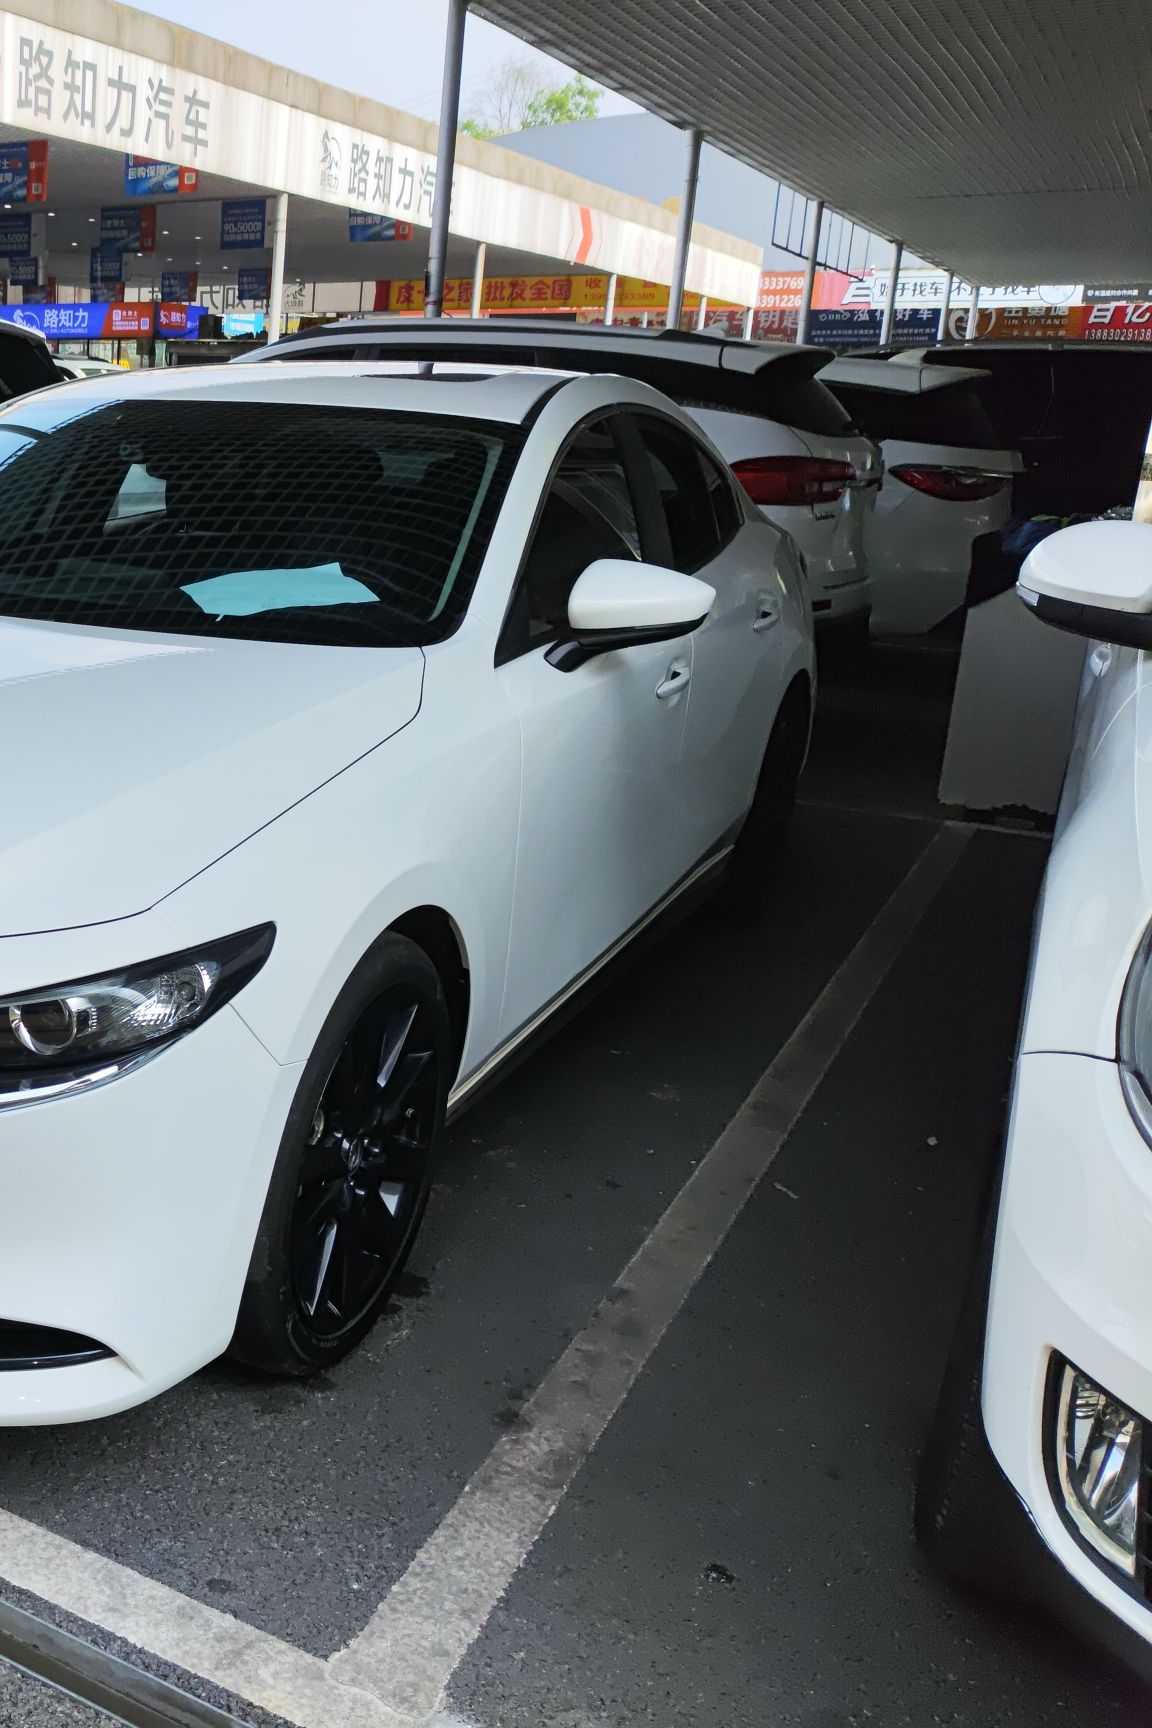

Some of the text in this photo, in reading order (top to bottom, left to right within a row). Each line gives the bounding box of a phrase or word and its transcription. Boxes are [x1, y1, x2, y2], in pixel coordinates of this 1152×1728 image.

[16, 36, 210, 158] 路知力汽车
[485, 279, 573, 302] 批发全国
[43, 308, 89, 328] 路知力
